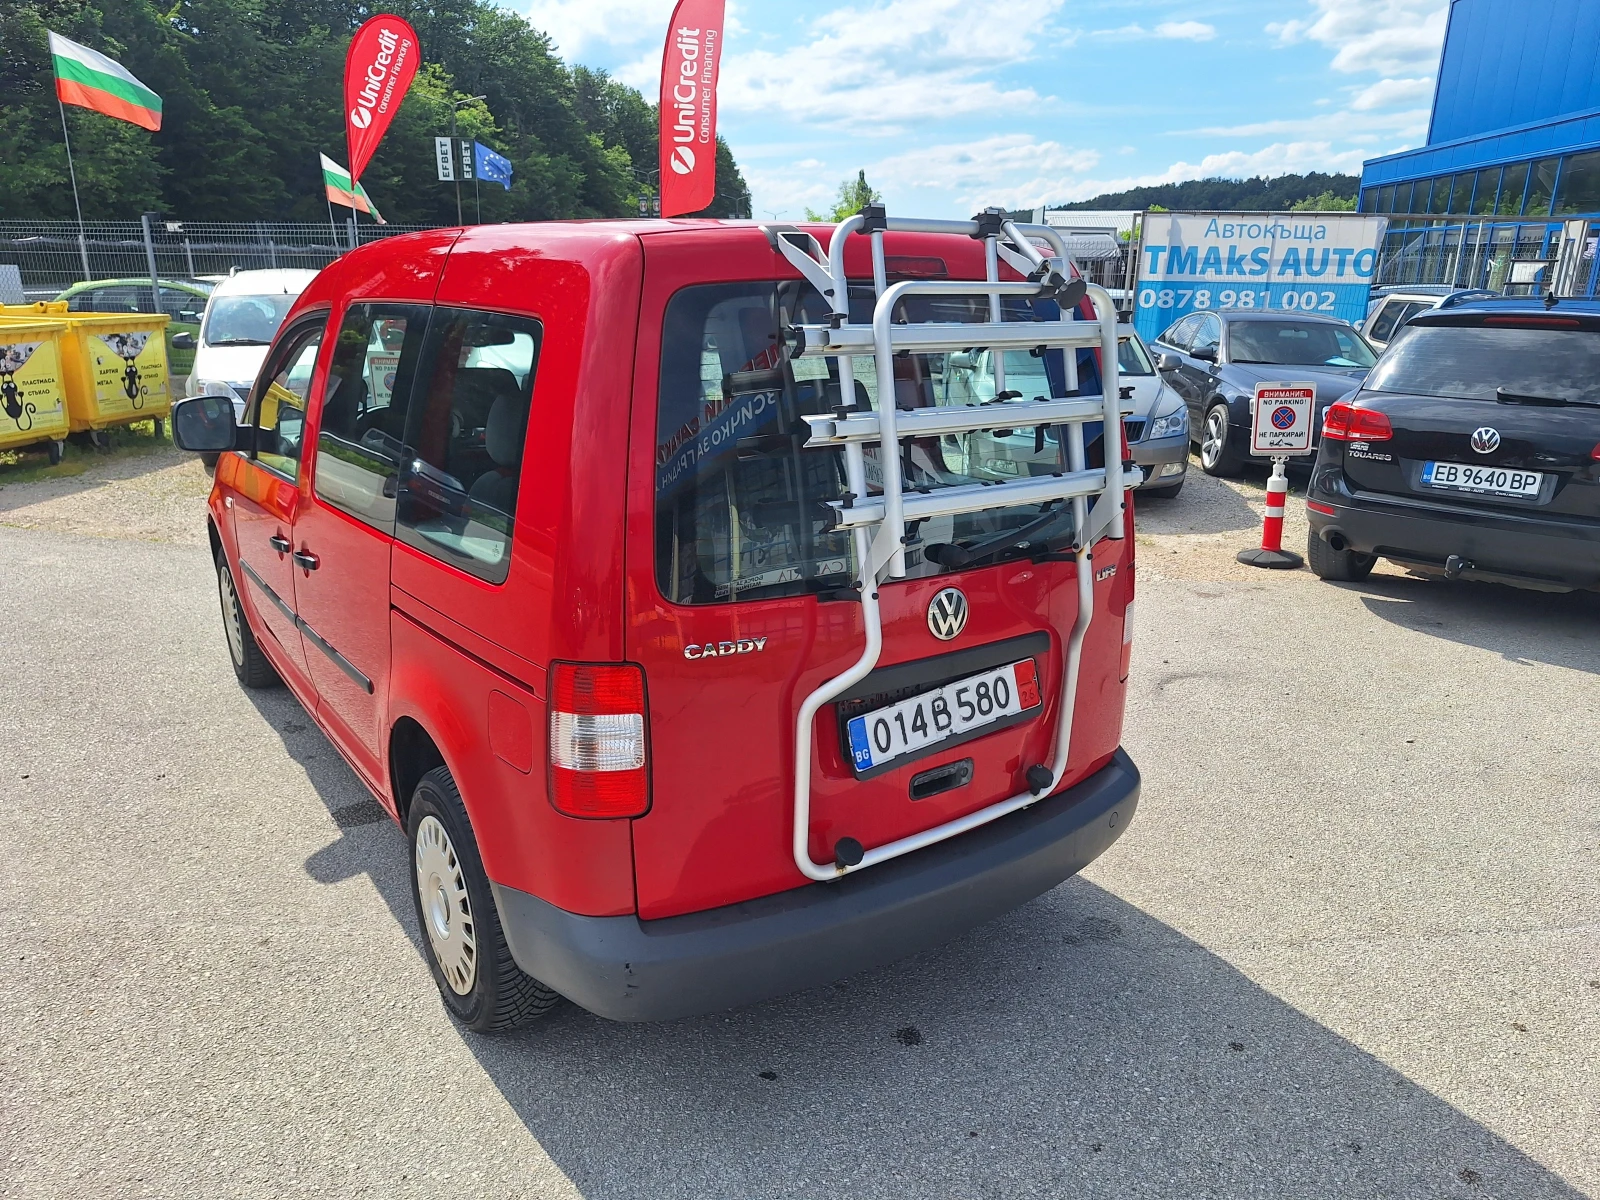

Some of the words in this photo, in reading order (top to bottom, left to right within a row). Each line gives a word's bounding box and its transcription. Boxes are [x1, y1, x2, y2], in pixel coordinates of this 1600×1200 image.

[357, 28, 399, 108] UniCredit
[700, 29, 718, 84] Financing
[377, 76, 397, 114] Consumer
[391, 38, 412, 75] Financing
[673, 26, 700, 143] UniCredit
[699, 87, 711, 144] Consumer
[440, 140, 450, 178] EFBET
[461, 140, 473, 179] EFBET
[1204, 218, 1326, 244] Автокъща
[1277, 247, 1377, 278] AUTO
[1138, 289, 1211, 310] 0878
[1219, 289, 1271, 310] 981
[1281, 290, 1337, 311] 002
[22, 378, 56, 386] ПЛАСТМАСА
[28, 388, 50, 397] СТЪКЛО
[1263, 390, 1307, 398] ВНИМАНИЕ!
[1463, 468, 1507, 489] 9640
[684, 636, 767, 660] CADDY
[855, 748, 870, 763] BG
